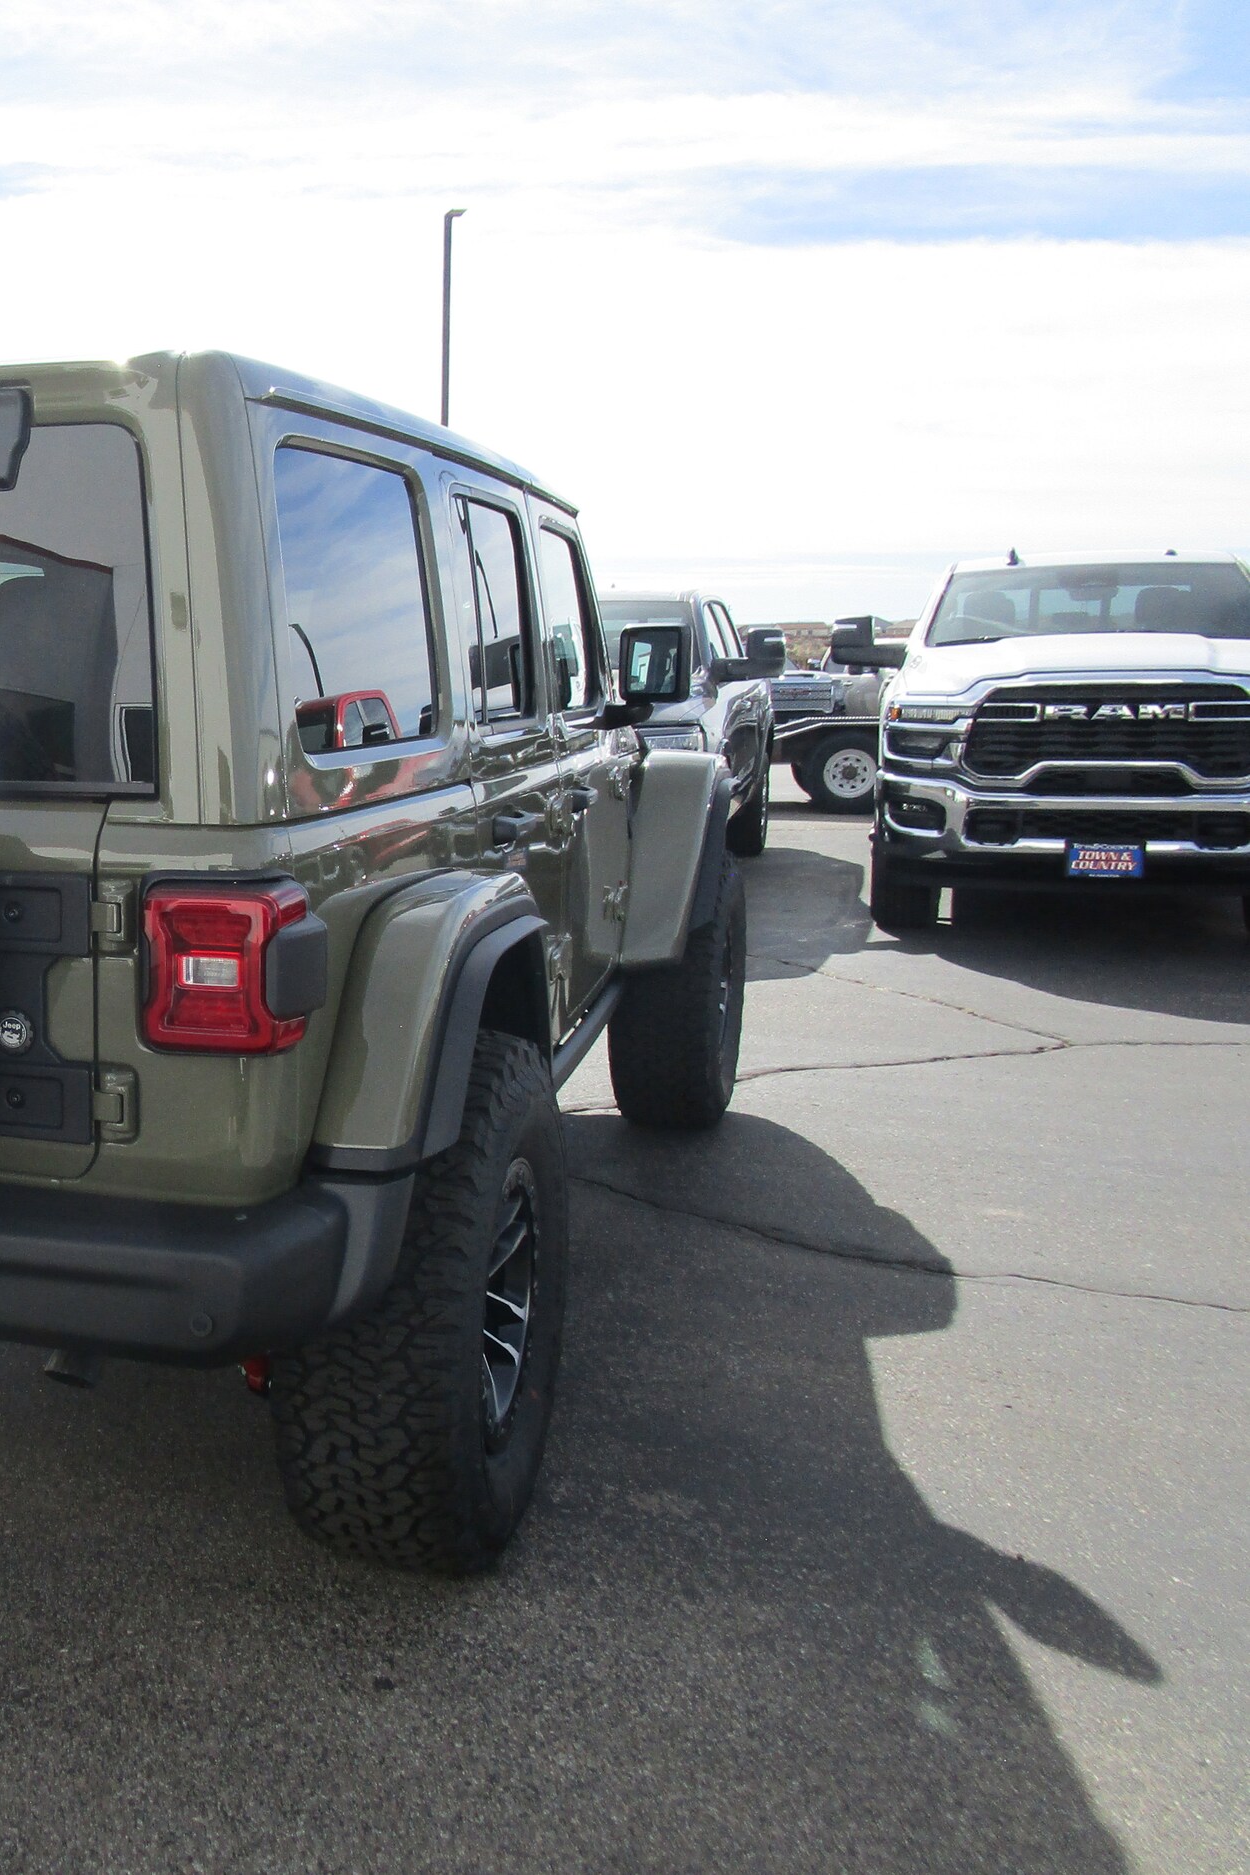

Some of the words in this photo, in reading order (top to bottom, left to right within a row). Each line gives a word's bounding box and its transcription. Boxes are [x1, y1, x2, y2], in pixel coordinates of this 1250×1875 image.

[1044, 703, 1186, 720] RAM
[1077, 850, 1119, 861] TOWN
[1120, 851, 1133, 862] &
[1070, 860, 1137, 871] COUNTRY
[2, 1021, 21, 1031] Jeep
